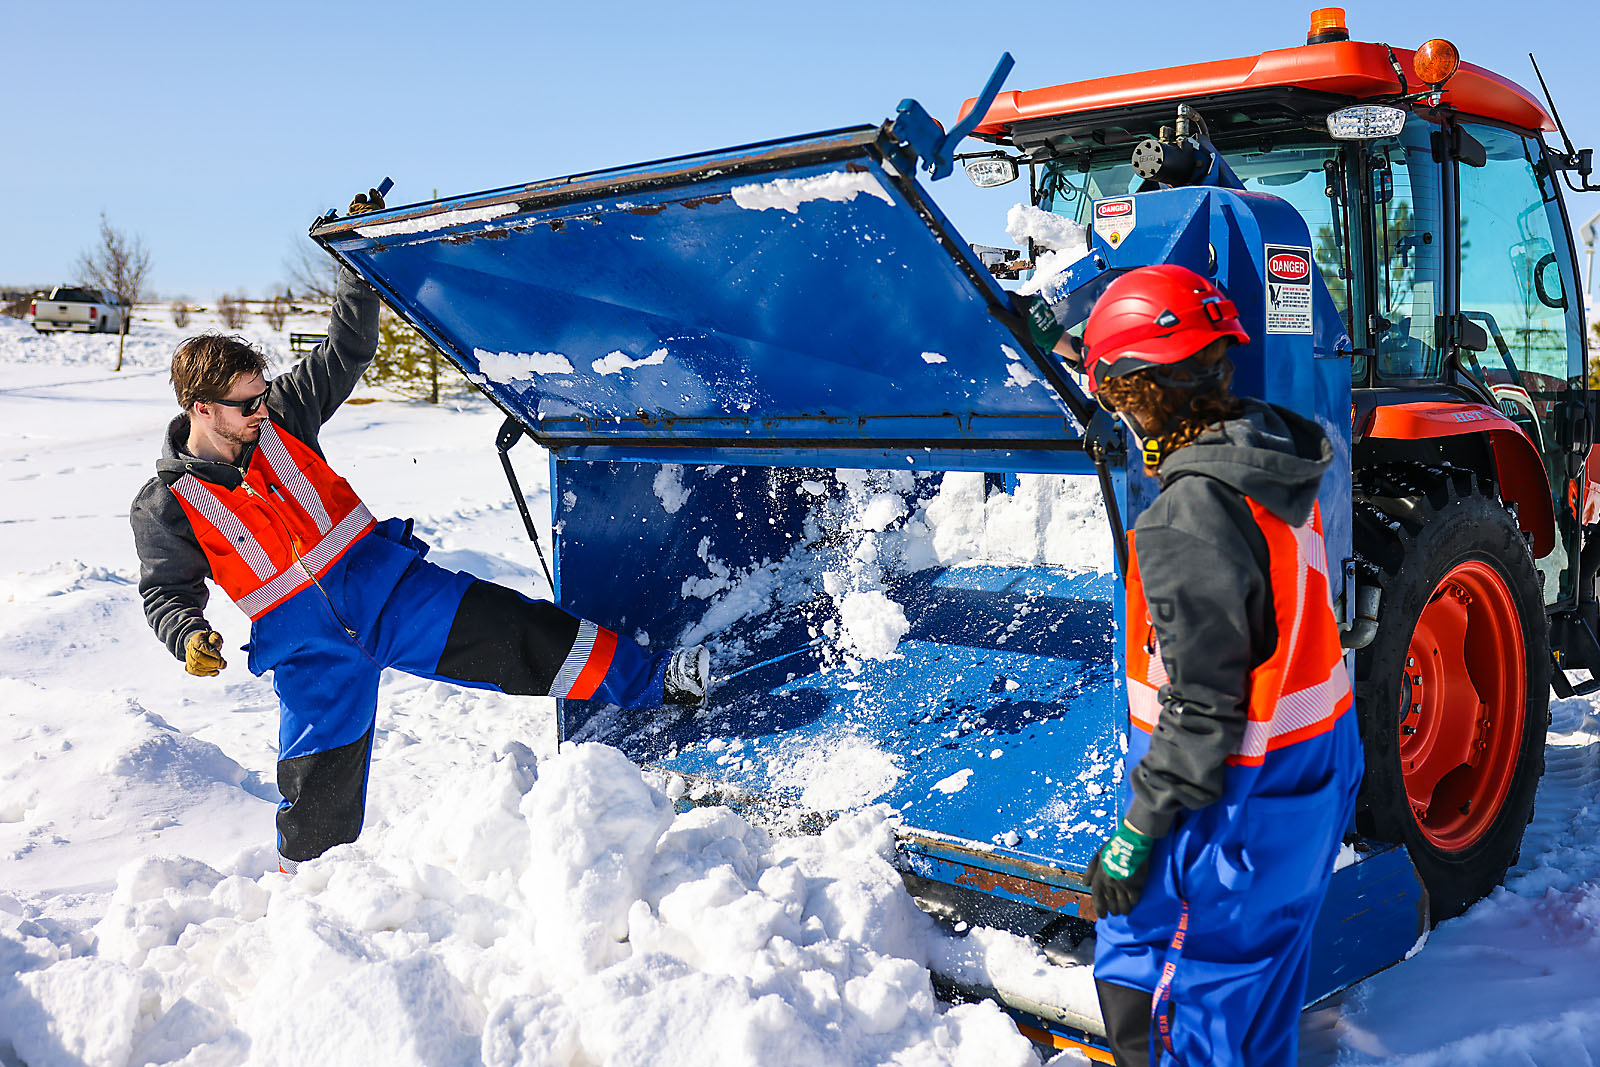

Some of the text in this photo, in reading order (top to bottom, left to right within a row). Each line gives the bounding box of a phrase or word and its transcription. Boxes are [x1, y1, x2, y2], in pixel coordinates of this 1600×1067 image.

[1101, 204, 1129, 214] DANGER
[1272, 259, 1305, 274] DANGER
[1452, 411, 1484, 422] HST
[1171, 931, 1185, 950] GEAR
